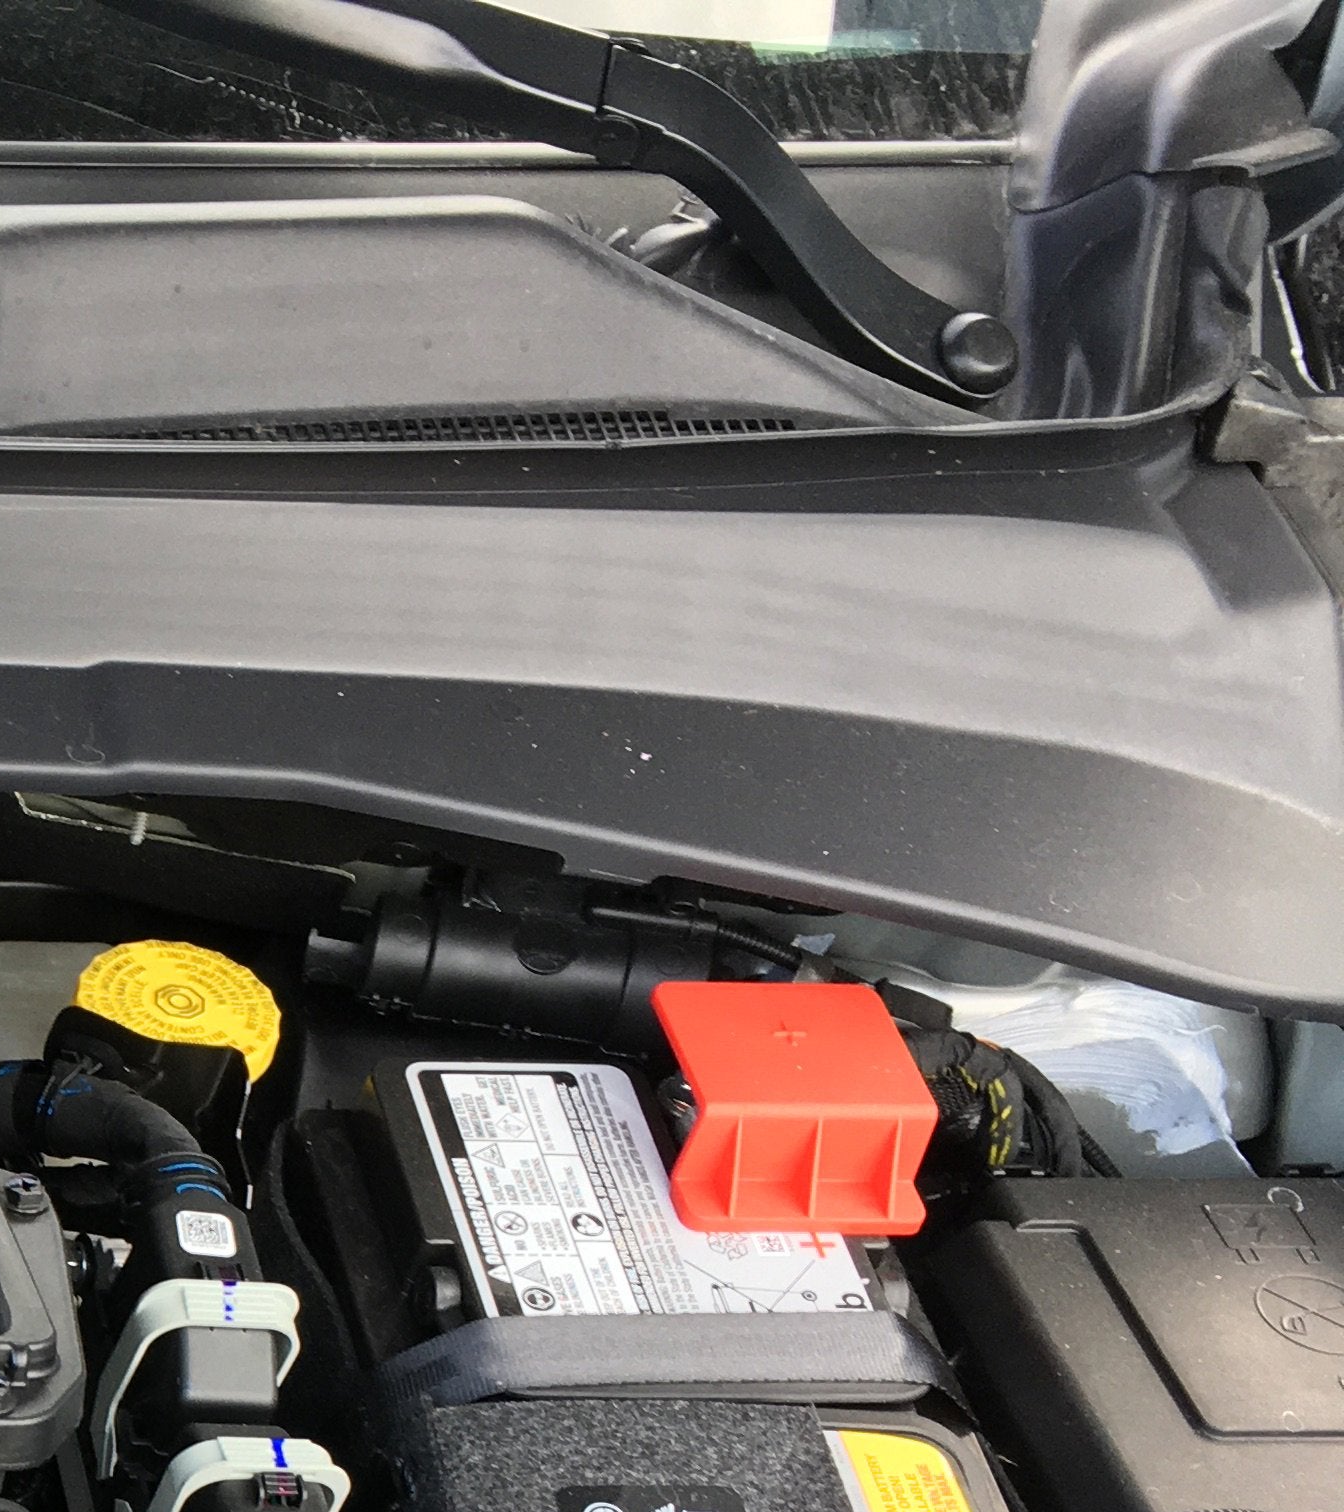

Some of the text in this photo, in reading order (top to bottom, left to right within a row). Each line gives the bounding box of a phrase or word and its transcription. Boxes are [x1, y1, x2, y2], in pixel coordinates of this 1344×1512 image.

[450, 1097, 465, 1114] EYES
[450, 1157, 504, 1265] DANGER/POISON
[513, 1239, 528, 1250] NO
[863, 1453, 894, 1502] BATTERY
